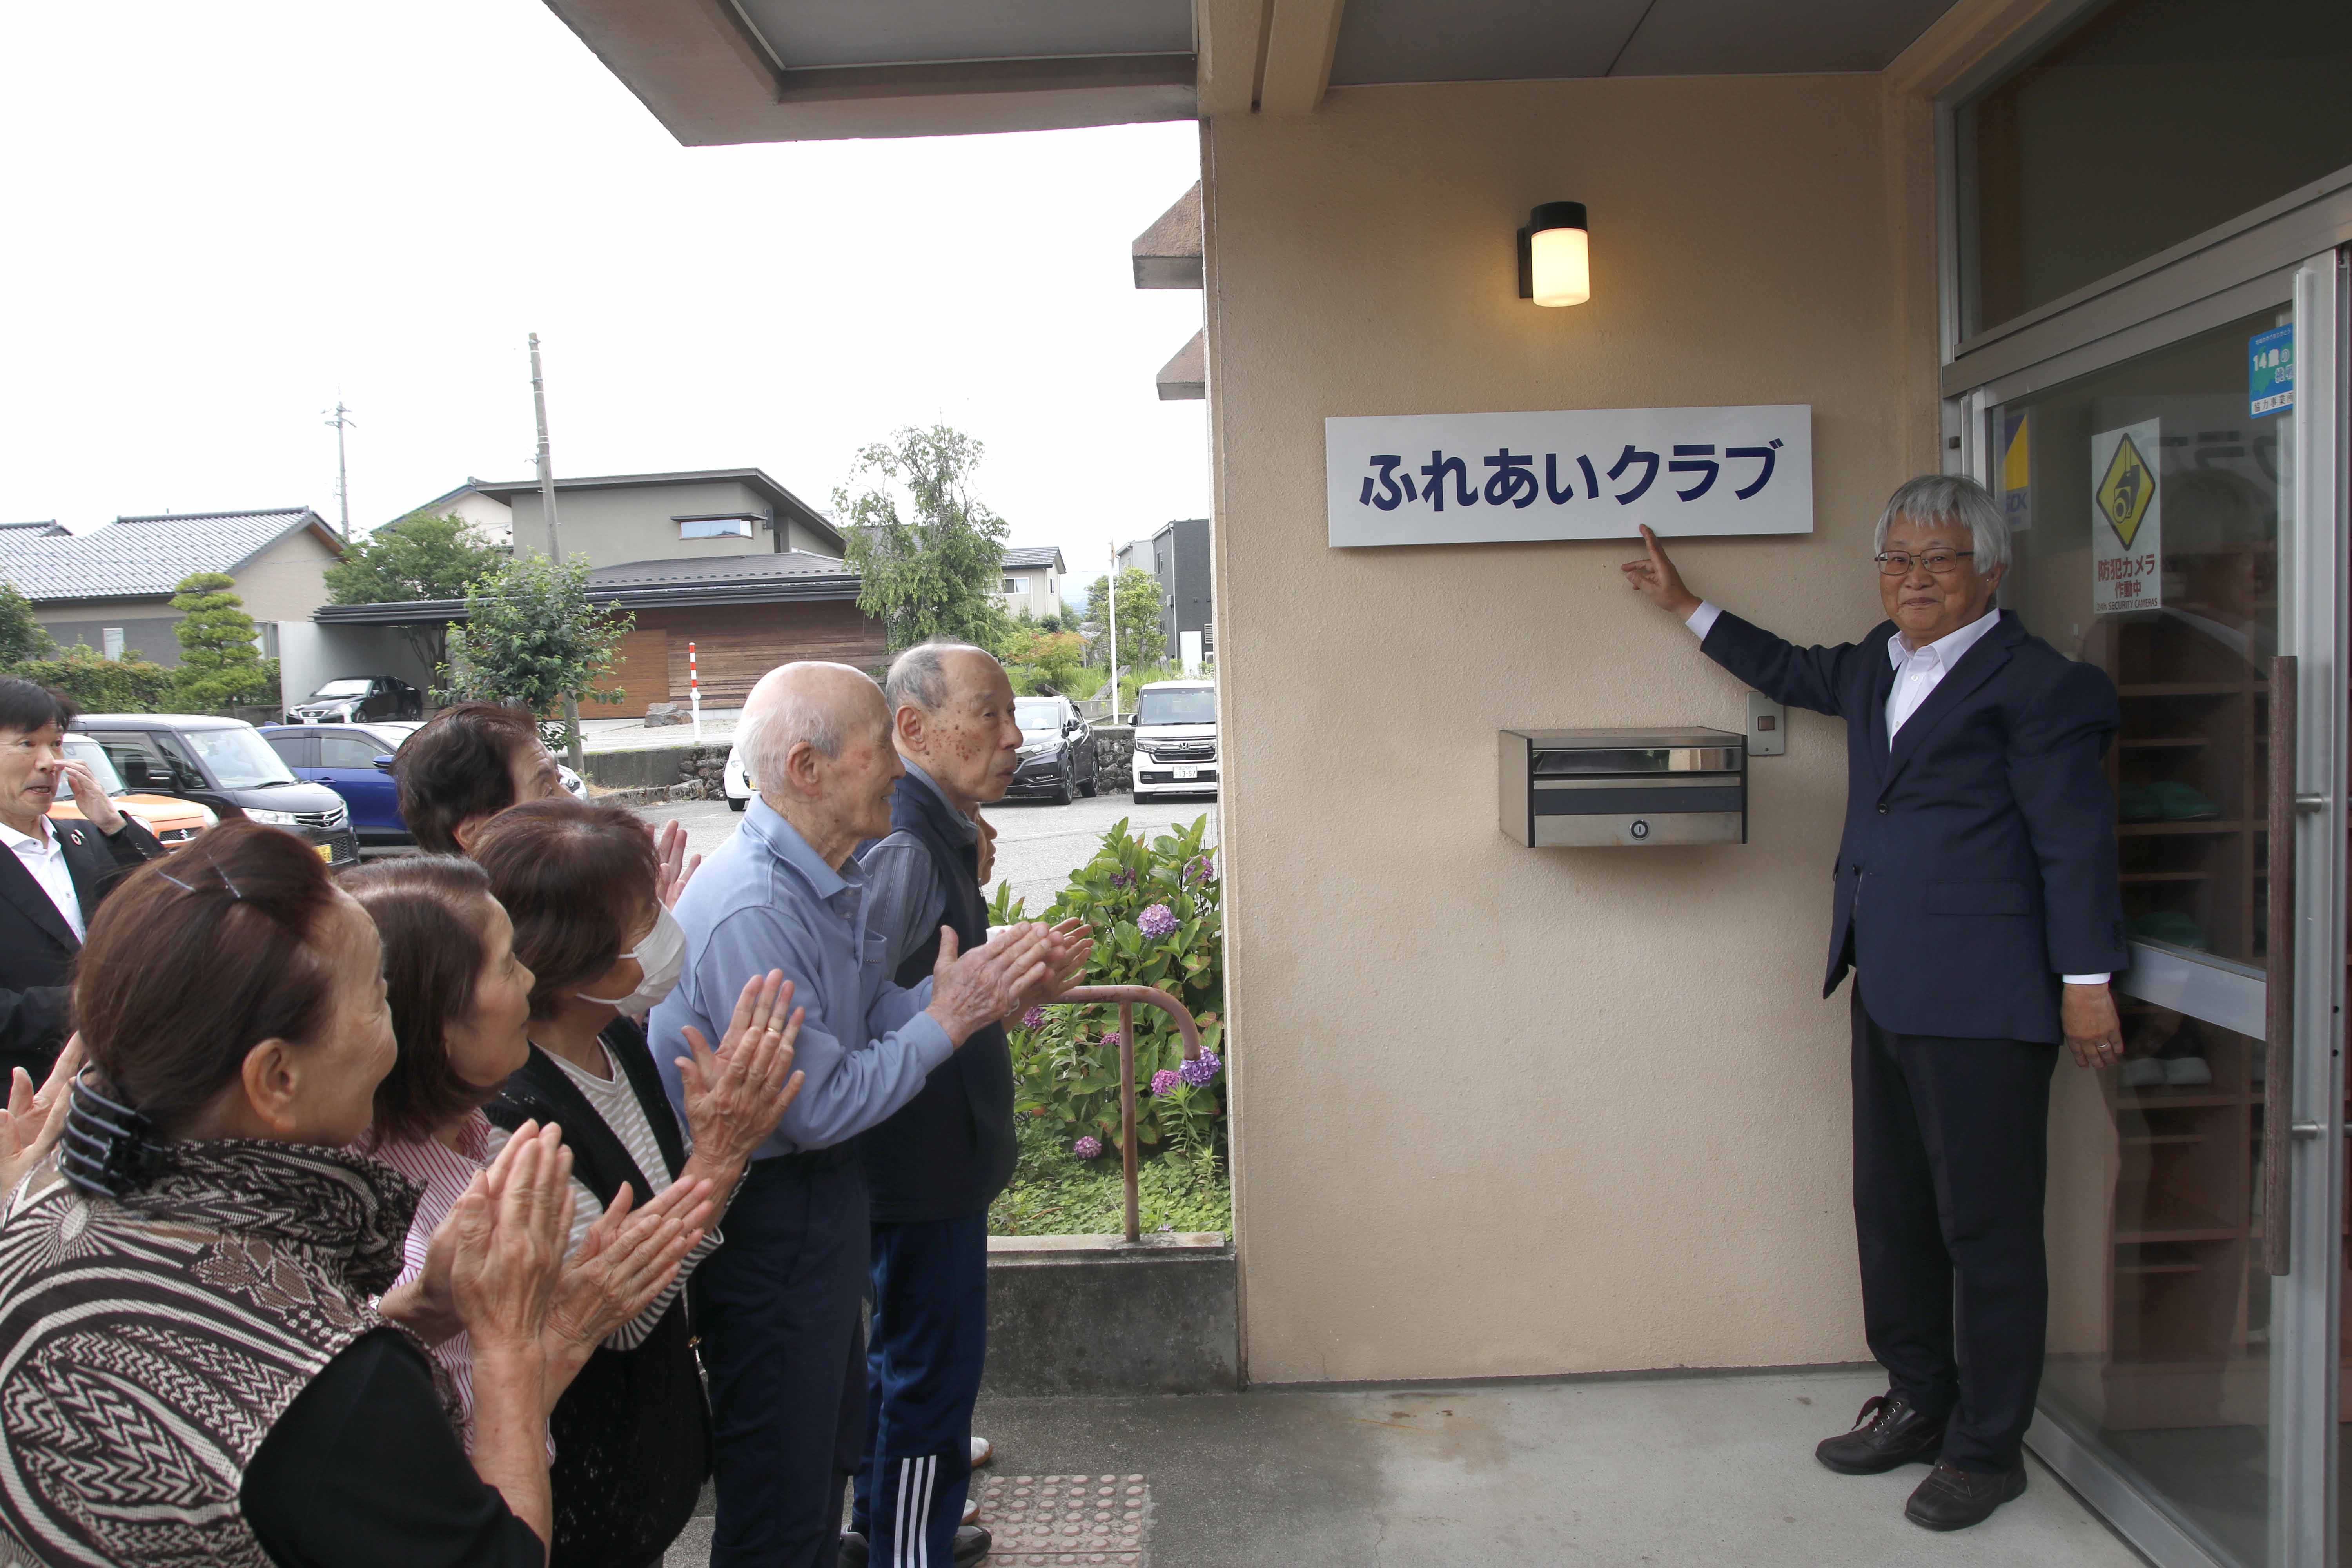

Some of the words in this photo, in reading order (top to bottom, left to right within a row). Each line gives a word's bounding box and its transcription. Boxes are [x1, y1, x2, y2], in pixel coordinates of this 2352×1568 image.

[1359, 438, 1784, 512] ふれあいクラブ
[2098, 554, 2155, 582] 防犯カメラ
[2114, 579, 2141, 599] 作動中
[2096, 602, 2107, 611] 24h
[2108, 600, 2133, 610] SECURITY
[2134, 598, 2158, 608] CAMERAS
